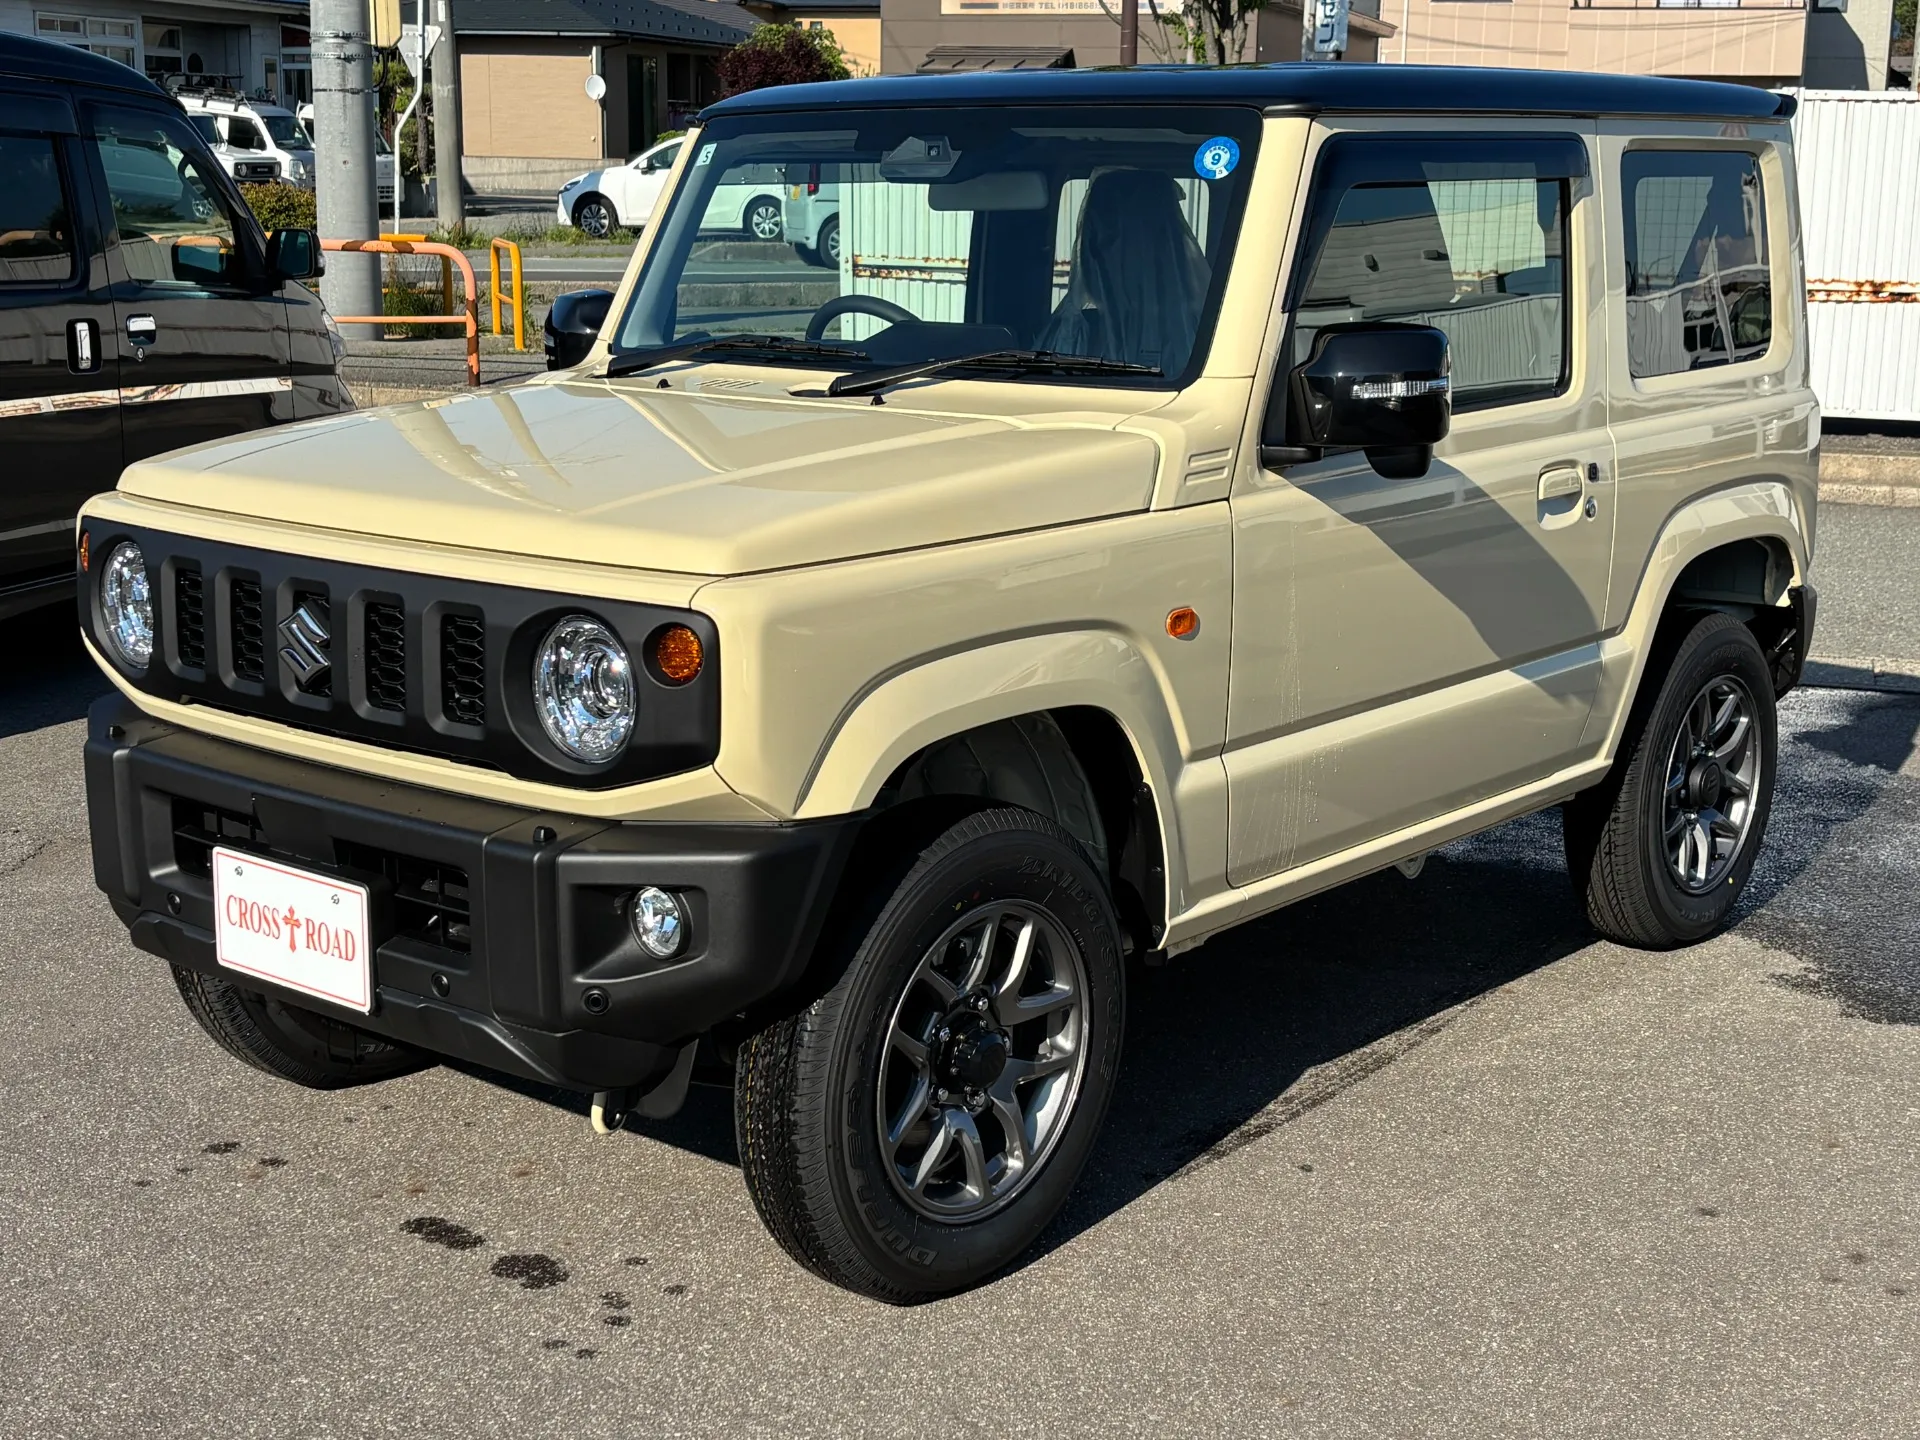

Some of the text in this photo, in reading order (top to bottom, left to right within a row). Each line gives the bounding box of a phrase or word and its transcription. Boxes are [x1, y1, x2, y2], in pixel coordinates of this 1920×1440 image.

[1038, 2, 1056, 10] TEL
[1210, 152, 1222, 166] 9
[226, 894, 356, 962] CROSS ROAD
